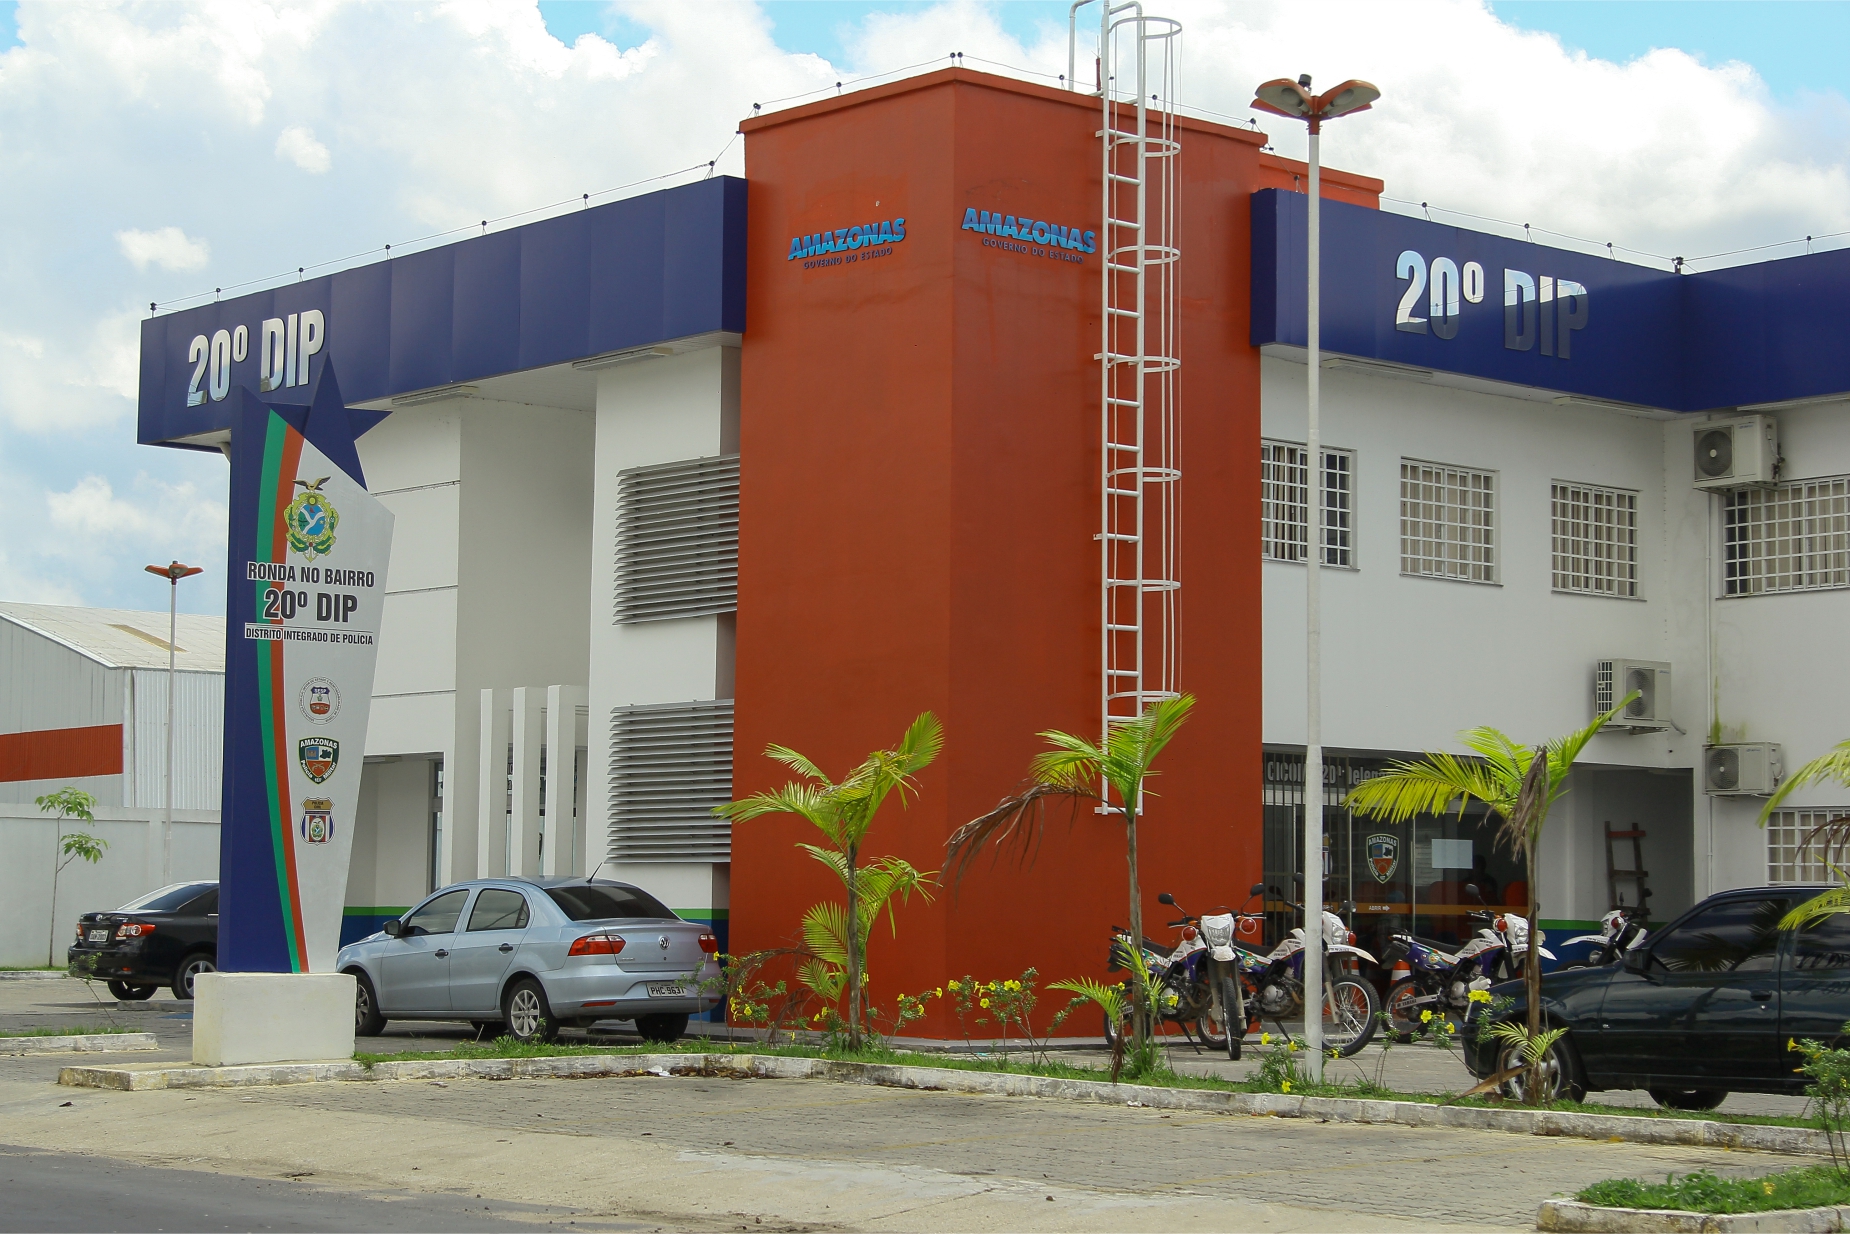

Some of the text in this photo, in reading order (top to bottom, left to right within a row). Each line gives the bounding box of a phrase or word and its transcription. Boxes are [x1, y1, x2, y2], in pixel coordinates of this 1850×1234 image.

[788, 217, 906, 261] AMAZONAS
[961, 207, 1097, 254] AMAZONAS
[803, 246, 893, 269] GOVERNO DO ESTADO
[982, 237, 1084, 265] GOVERNO DO ESTADO
[1395, 250, 1589, 360] 20º DIP
[187, 309, 325, 408] 20º DIP
[248, 562, 374, 587] RONDA NO BAIRRO
[264, 590, 358, 623] 20º DIP
[246, 627, 373, 645] DISTRITO INTEGRADO DE POLÍCIA
[300, 738, 338, 749] AMAZONAS
[1369, 836, 1397, 846] AMAZONAS
